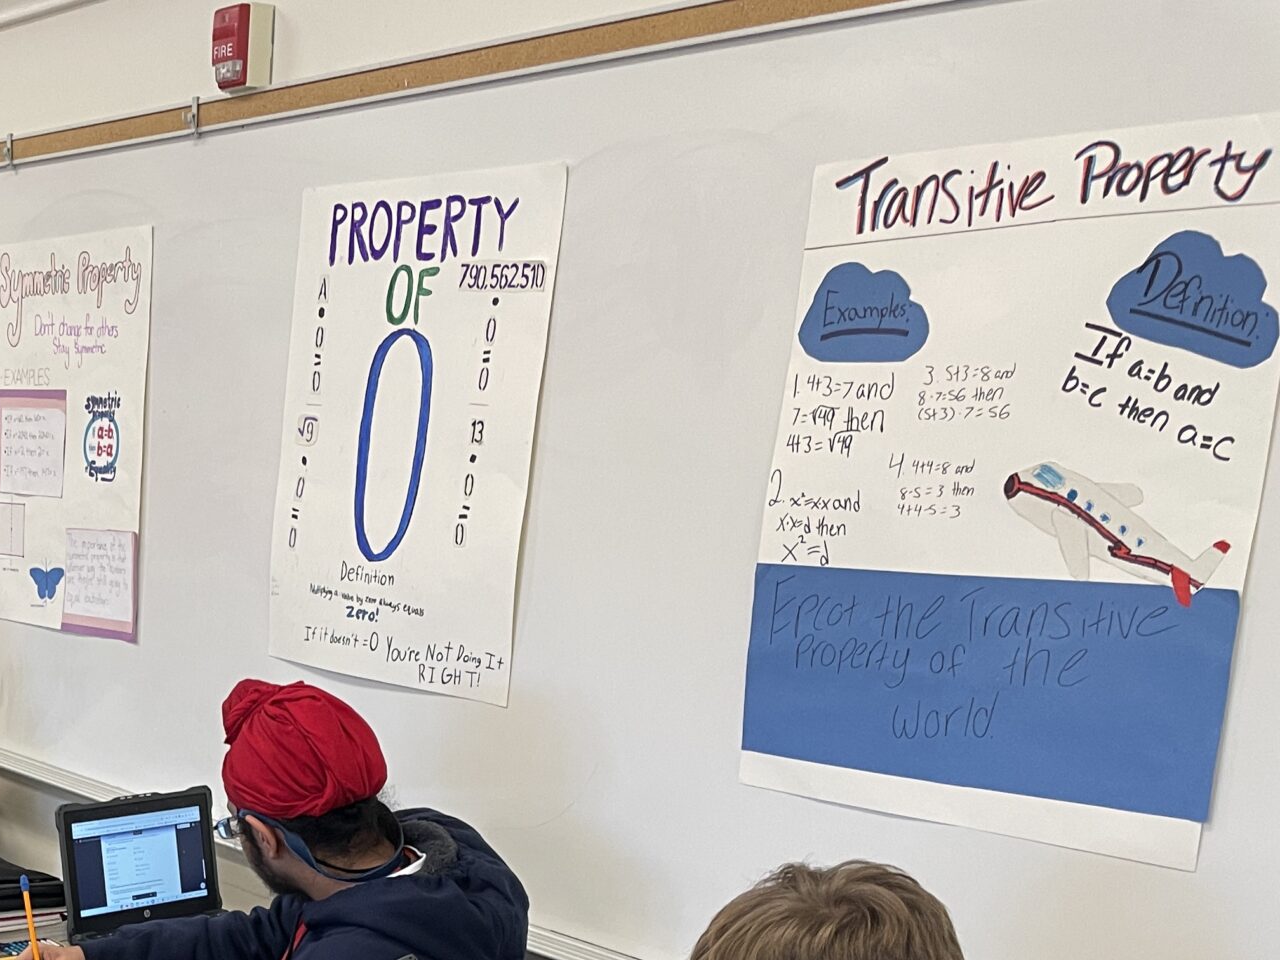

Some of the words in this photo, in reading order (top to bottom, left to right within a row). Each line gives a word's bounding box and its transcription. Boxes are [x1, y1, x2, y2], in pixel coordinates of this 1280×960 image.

[213, 43, 233, 59] FIRE
[836, 156, 1055, 235] Transitive
[1075, 140, 1273, 204] Property
[329, 195, 520, 267] PROPERTY
[0, 252, 70, 347] Symmetric
[77, 246, 141, 314] Property
[386, 264, 440, 325] OF
[994, 363, 1017, 379] and
[1073, 322, 1133, 367] If
[1174, 382, 1220, 407] and
[856, 372, 895, 400] and
[972, 387, 1004, 401] then
[843, 406, 885, 433] then
[1118, 395, 1169, 433] then
[354, 328, 433, 562] 0
[955, 459, 975, 474] and
[832, 490, 861, 513] and
[952, 482, 975, 497] then
[816, 516, 846, 537] then
[340, 560, 395, 586] Definition
[875, 590, 943, 640] the
[962, 586, 1180, 642] Transitive
[304, 626, 317, 642] If
[320, 627, 328, 641] it
[329, 629, 360, 648] doesn't
[386, 635, 420, 663] You're
[426, 641, 453, 663] Not
[457, 645, 481, 668] Doing
[794, 633, 912, 689] Property
[929, 645, 967, 678] of
[1002, 638, 1091, 688] the
[419, 664, 481, 688] RIGHT!
